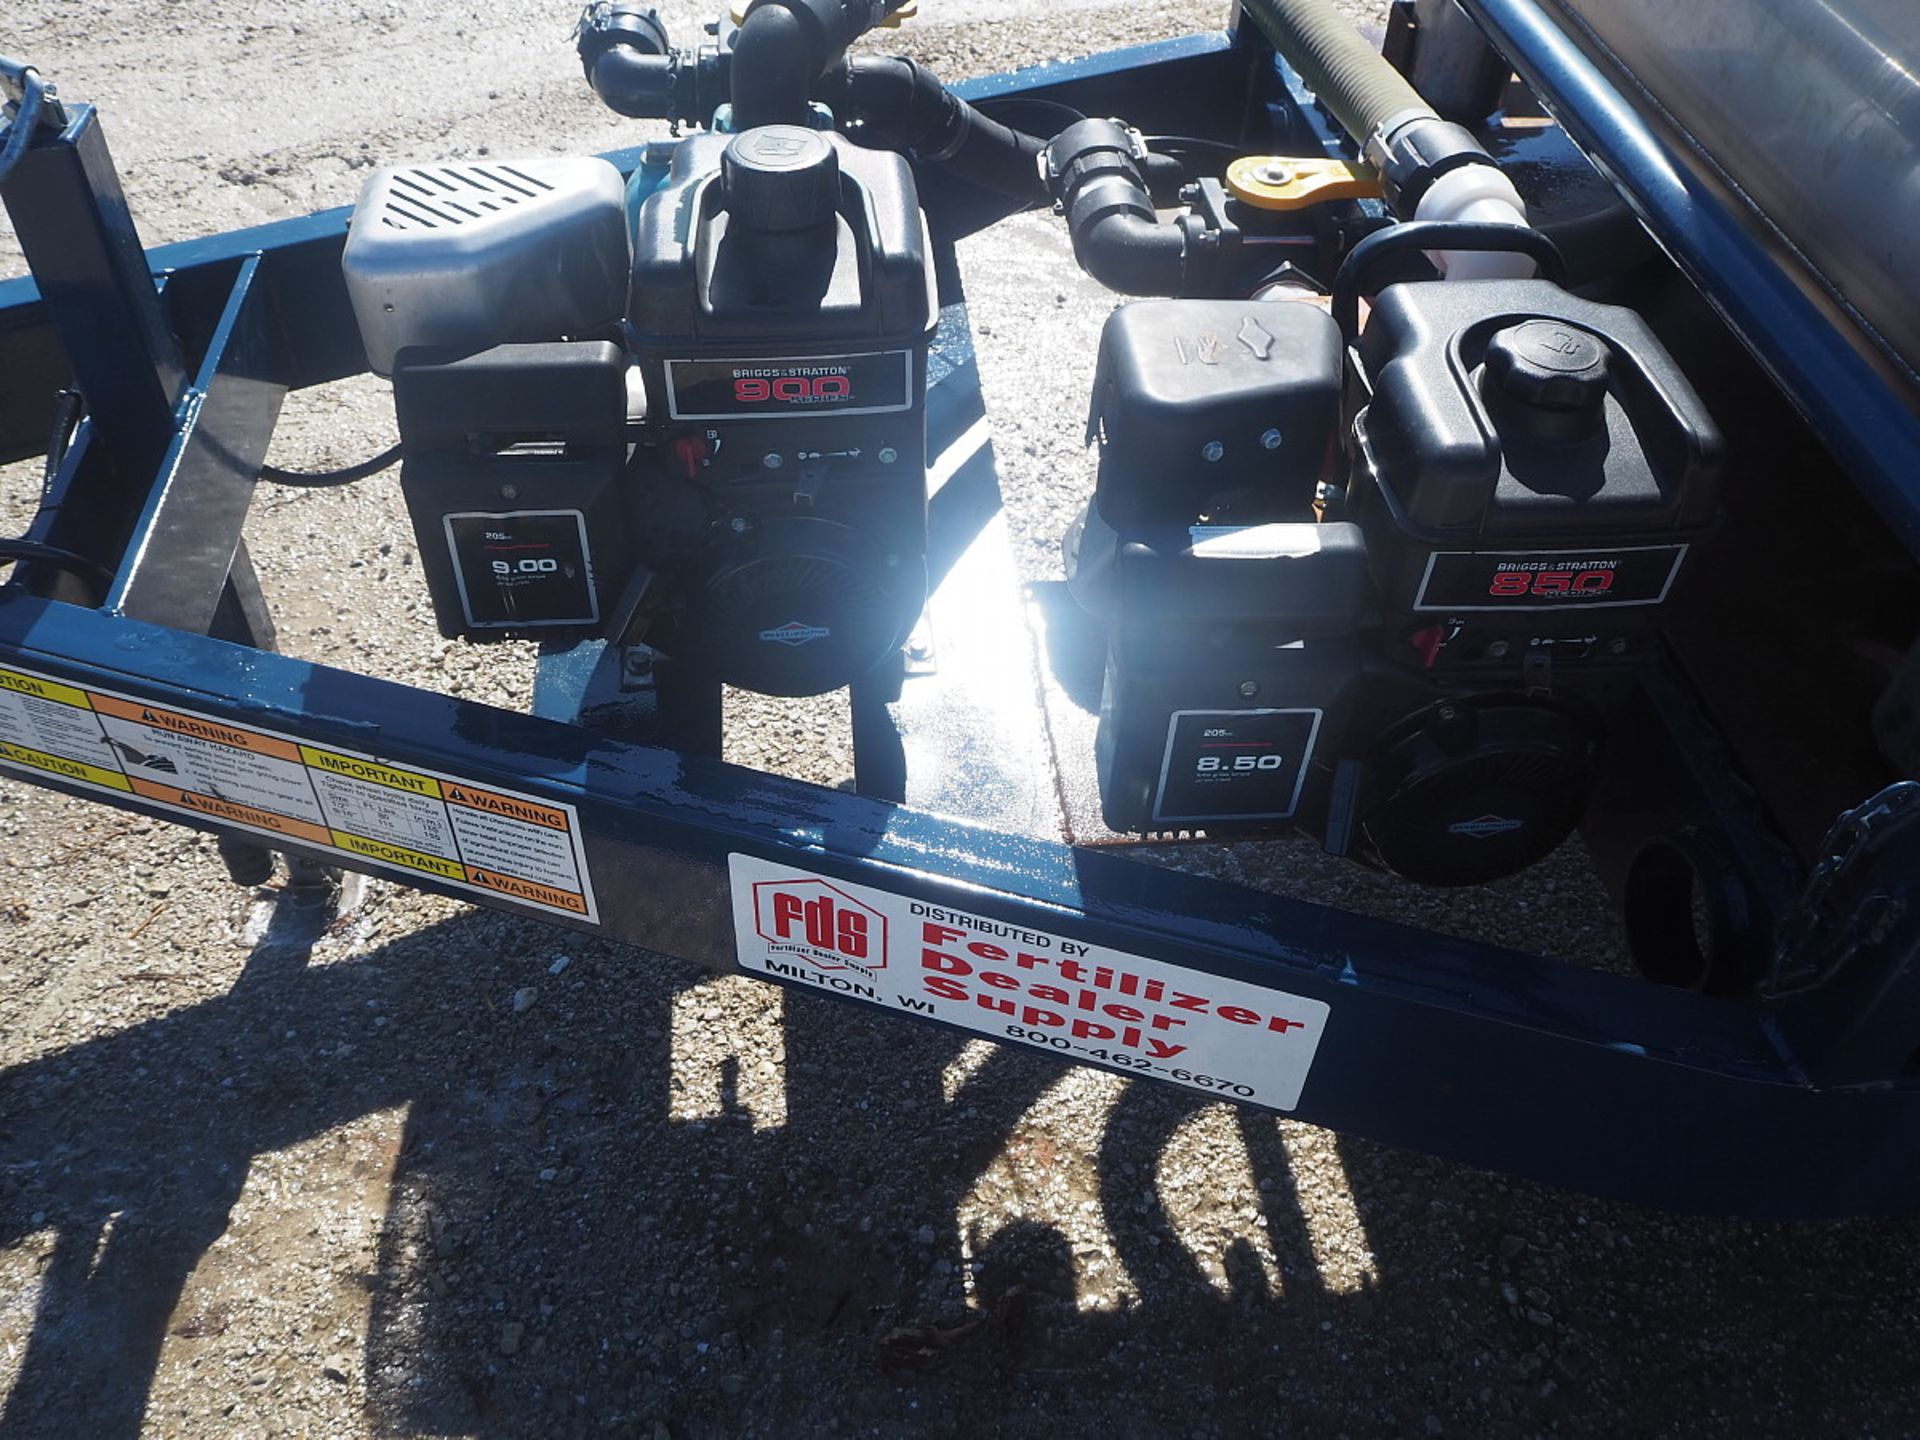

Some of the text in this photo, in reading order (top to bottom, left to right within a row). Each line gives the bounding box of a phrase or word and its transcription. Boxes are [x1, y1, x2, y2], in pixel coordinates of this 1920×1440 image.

[735, 376, 850, 402] 900
[492, 559, 557, 574] 9.00
[1489, 570, 1614, 596] 850
[158, 715, 248, 746] WARNING
[14, 750, 87, 777] CAUTION
[319, 755, 426, 791] IMPORTANT
[1197, 755, 1282, 771] 8.50
[200, 799, 281, 830] WARNING
[470, 793, 561, 826] WARNING
[350, 839, 451, 875] IMPORTANT
[492, 877, 580, 910] WARNING
[909, 902, 1090, 958] DISTRIBUTED BY
[765, 959, 935, 1014] MILTON, WI
[921, 948, 1187, 1032] Dealer
[922, 920, 1305, 1035] Fertilizer
[922, 975, 1188, 1060] Supply
[1005, 1023, 1256, 1098] 800-462-6670
